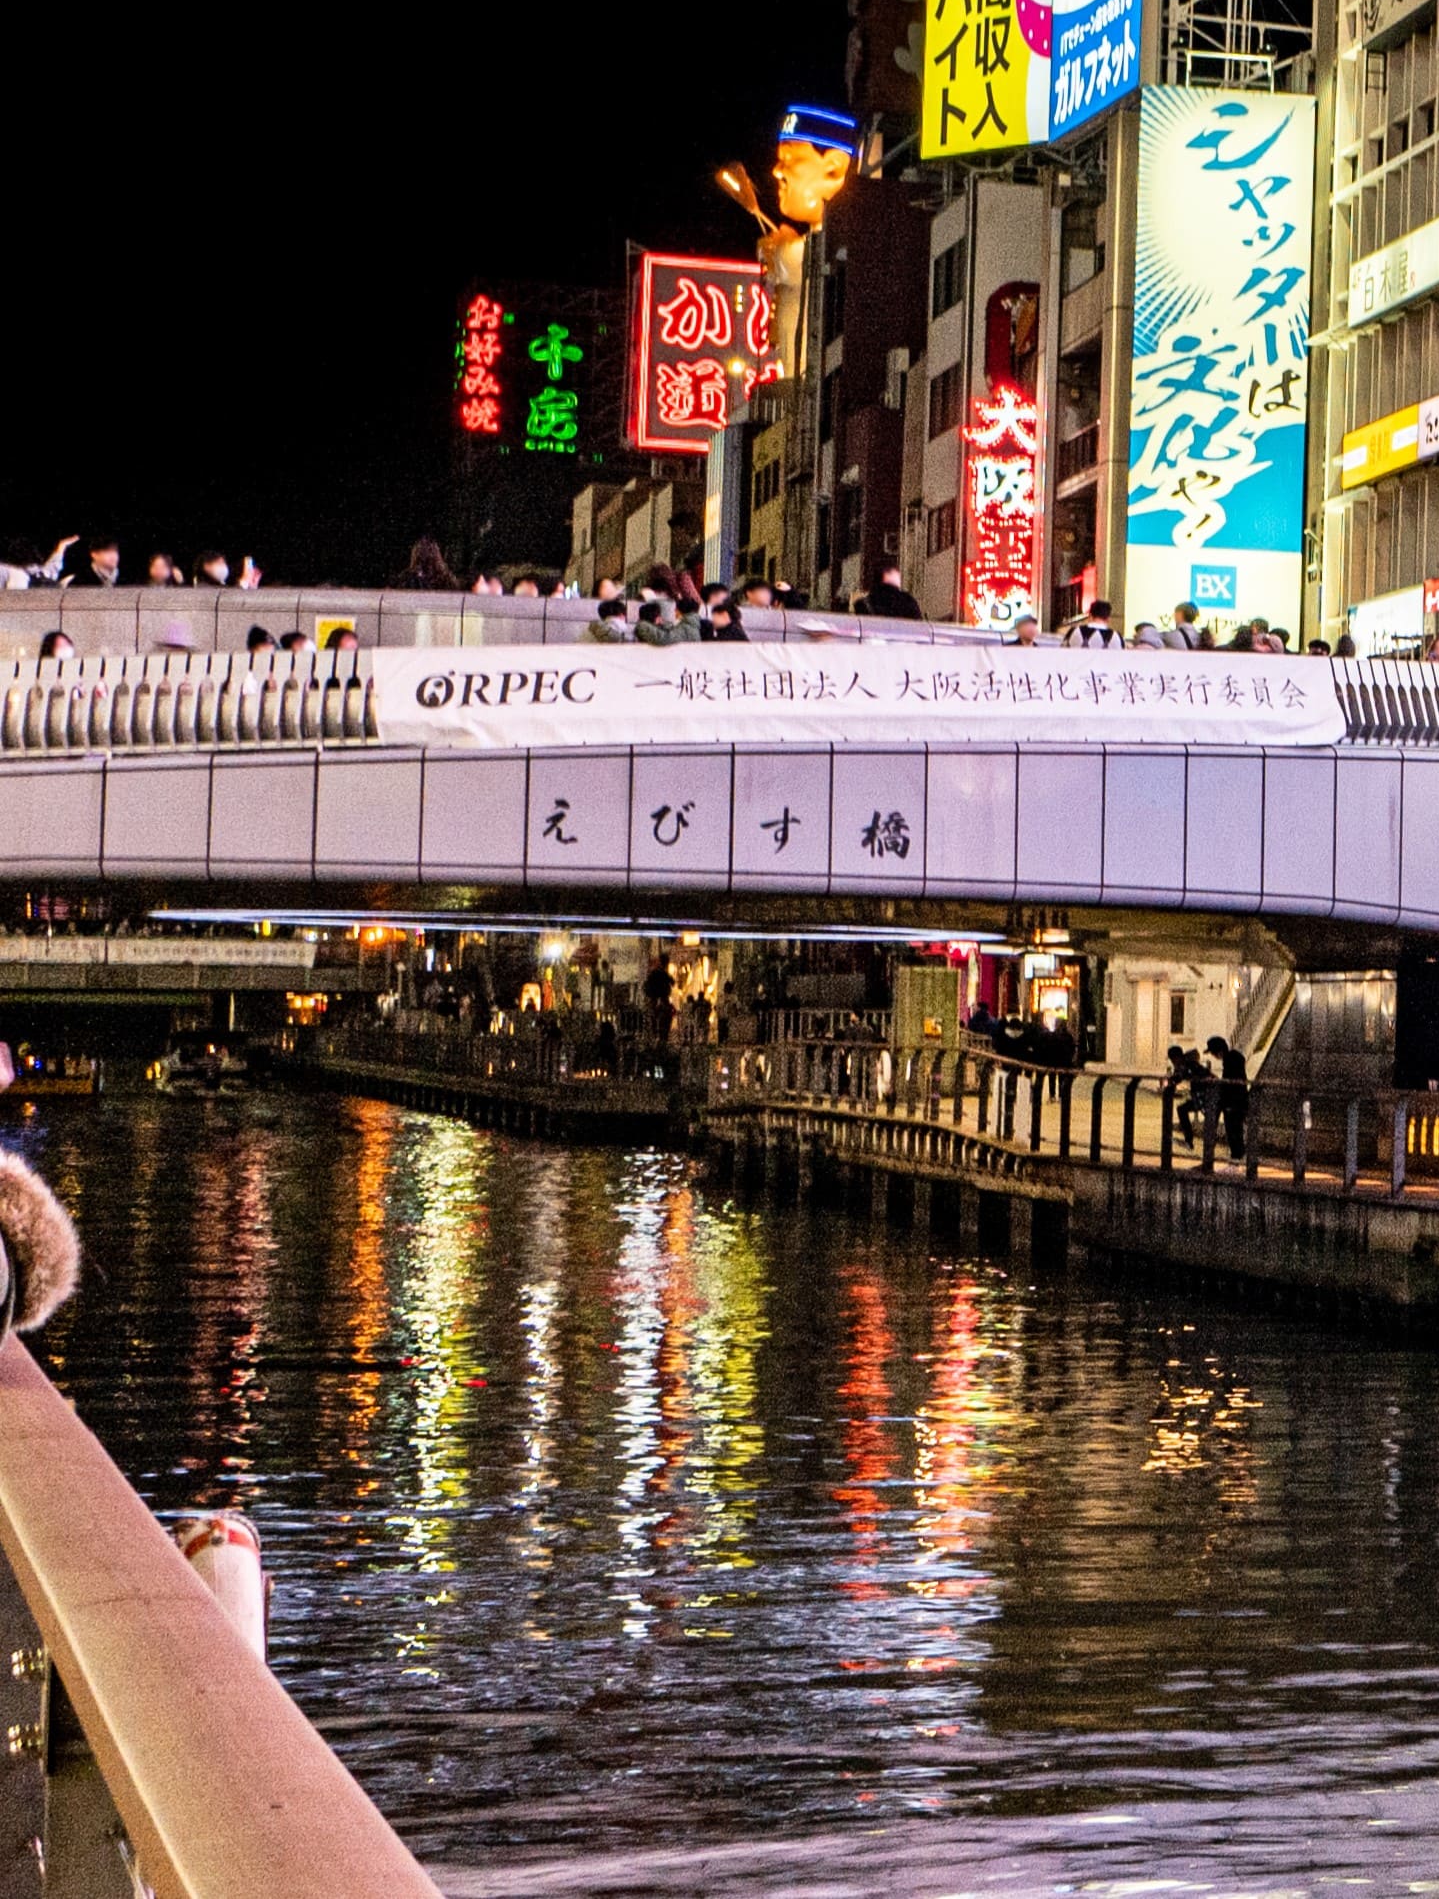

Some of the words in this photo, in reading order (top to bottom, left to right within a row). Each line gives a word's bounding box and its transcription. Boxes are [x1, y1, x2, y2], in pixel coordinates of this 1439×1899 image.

[1053, 18, 1137, 126] ガルフネット
[1196, 572, 1231, 600] BX
[415, 667, 599, 711] ORPEC
[633, 667, 878, 702] 一般社団法人
[541, 797, 911, 861] えびす橋
